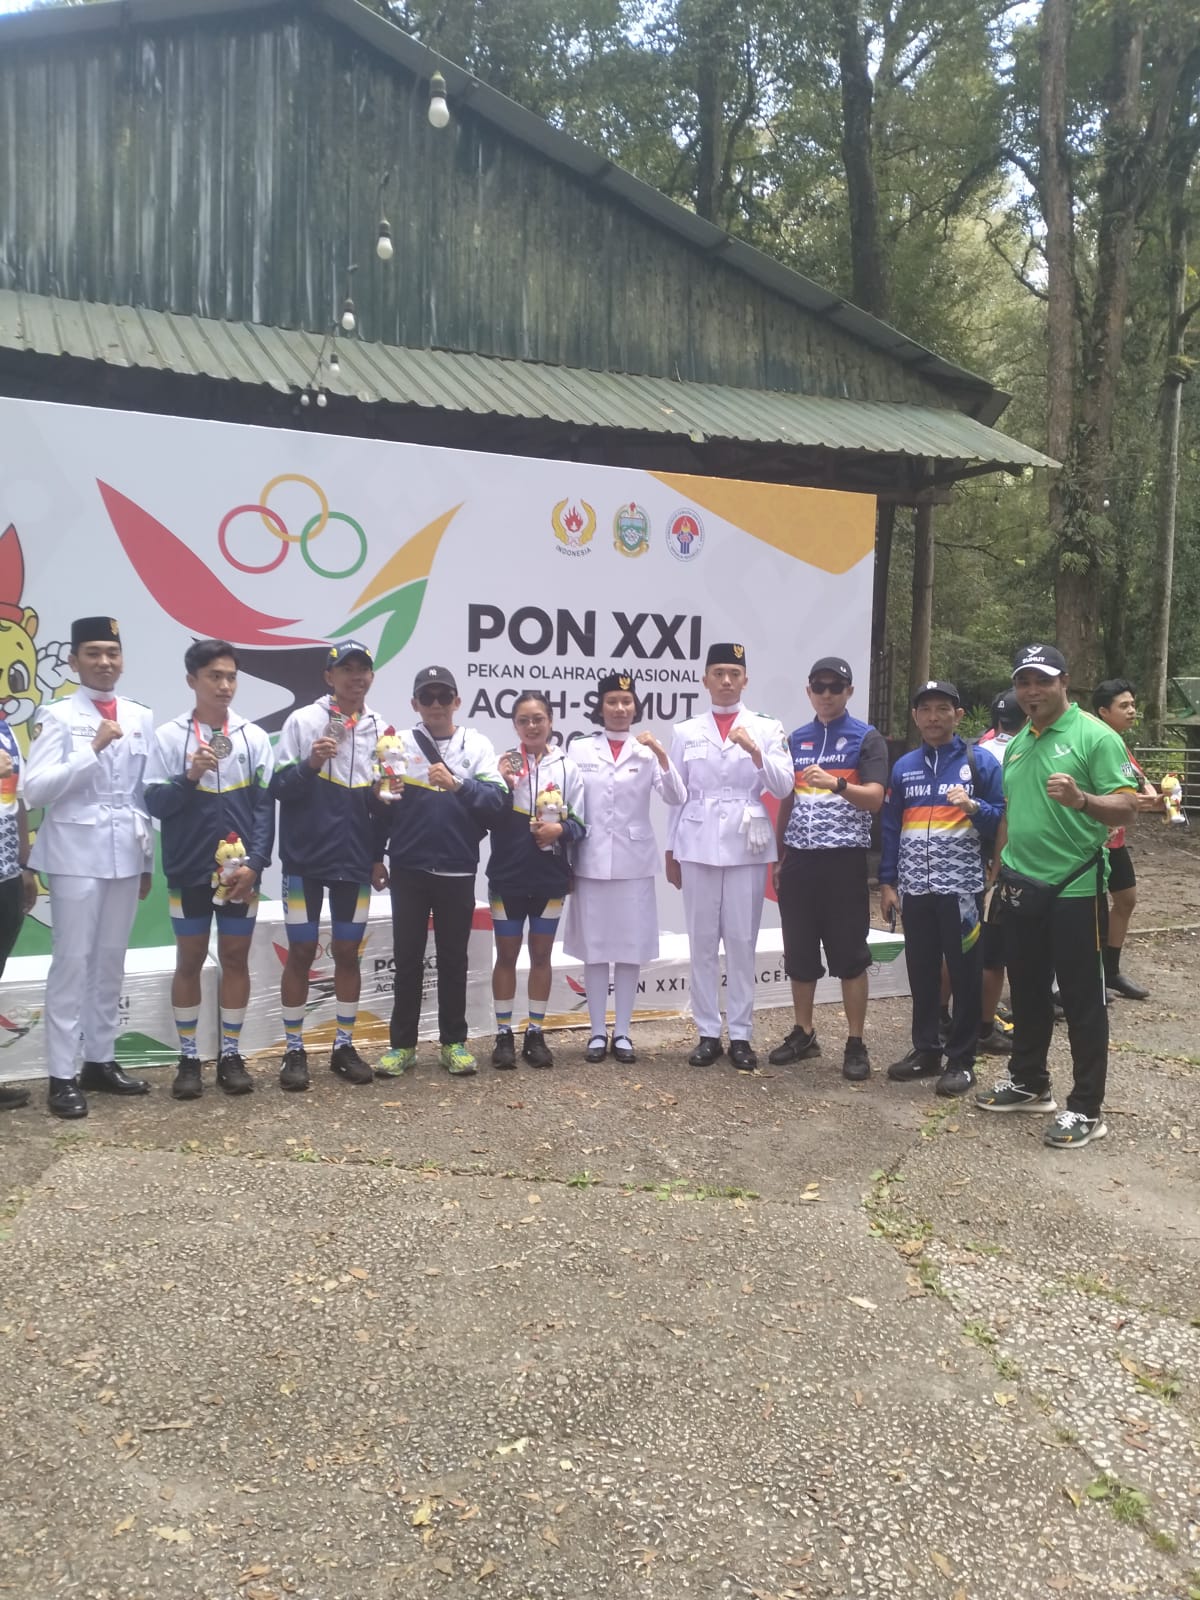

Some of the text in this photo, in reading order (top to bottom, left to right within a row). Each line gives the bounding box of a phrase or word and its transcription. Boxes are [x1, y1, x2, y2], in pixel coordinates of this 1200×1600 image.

[555, 545, 592, 557] INDONESIA
[467, 603, 702, 660] PON XXI
[467, 663, 525, 679] PEKAN
[904, 784, 932, 800] JAWA
[608, 978, 685, 996] PN XXI
